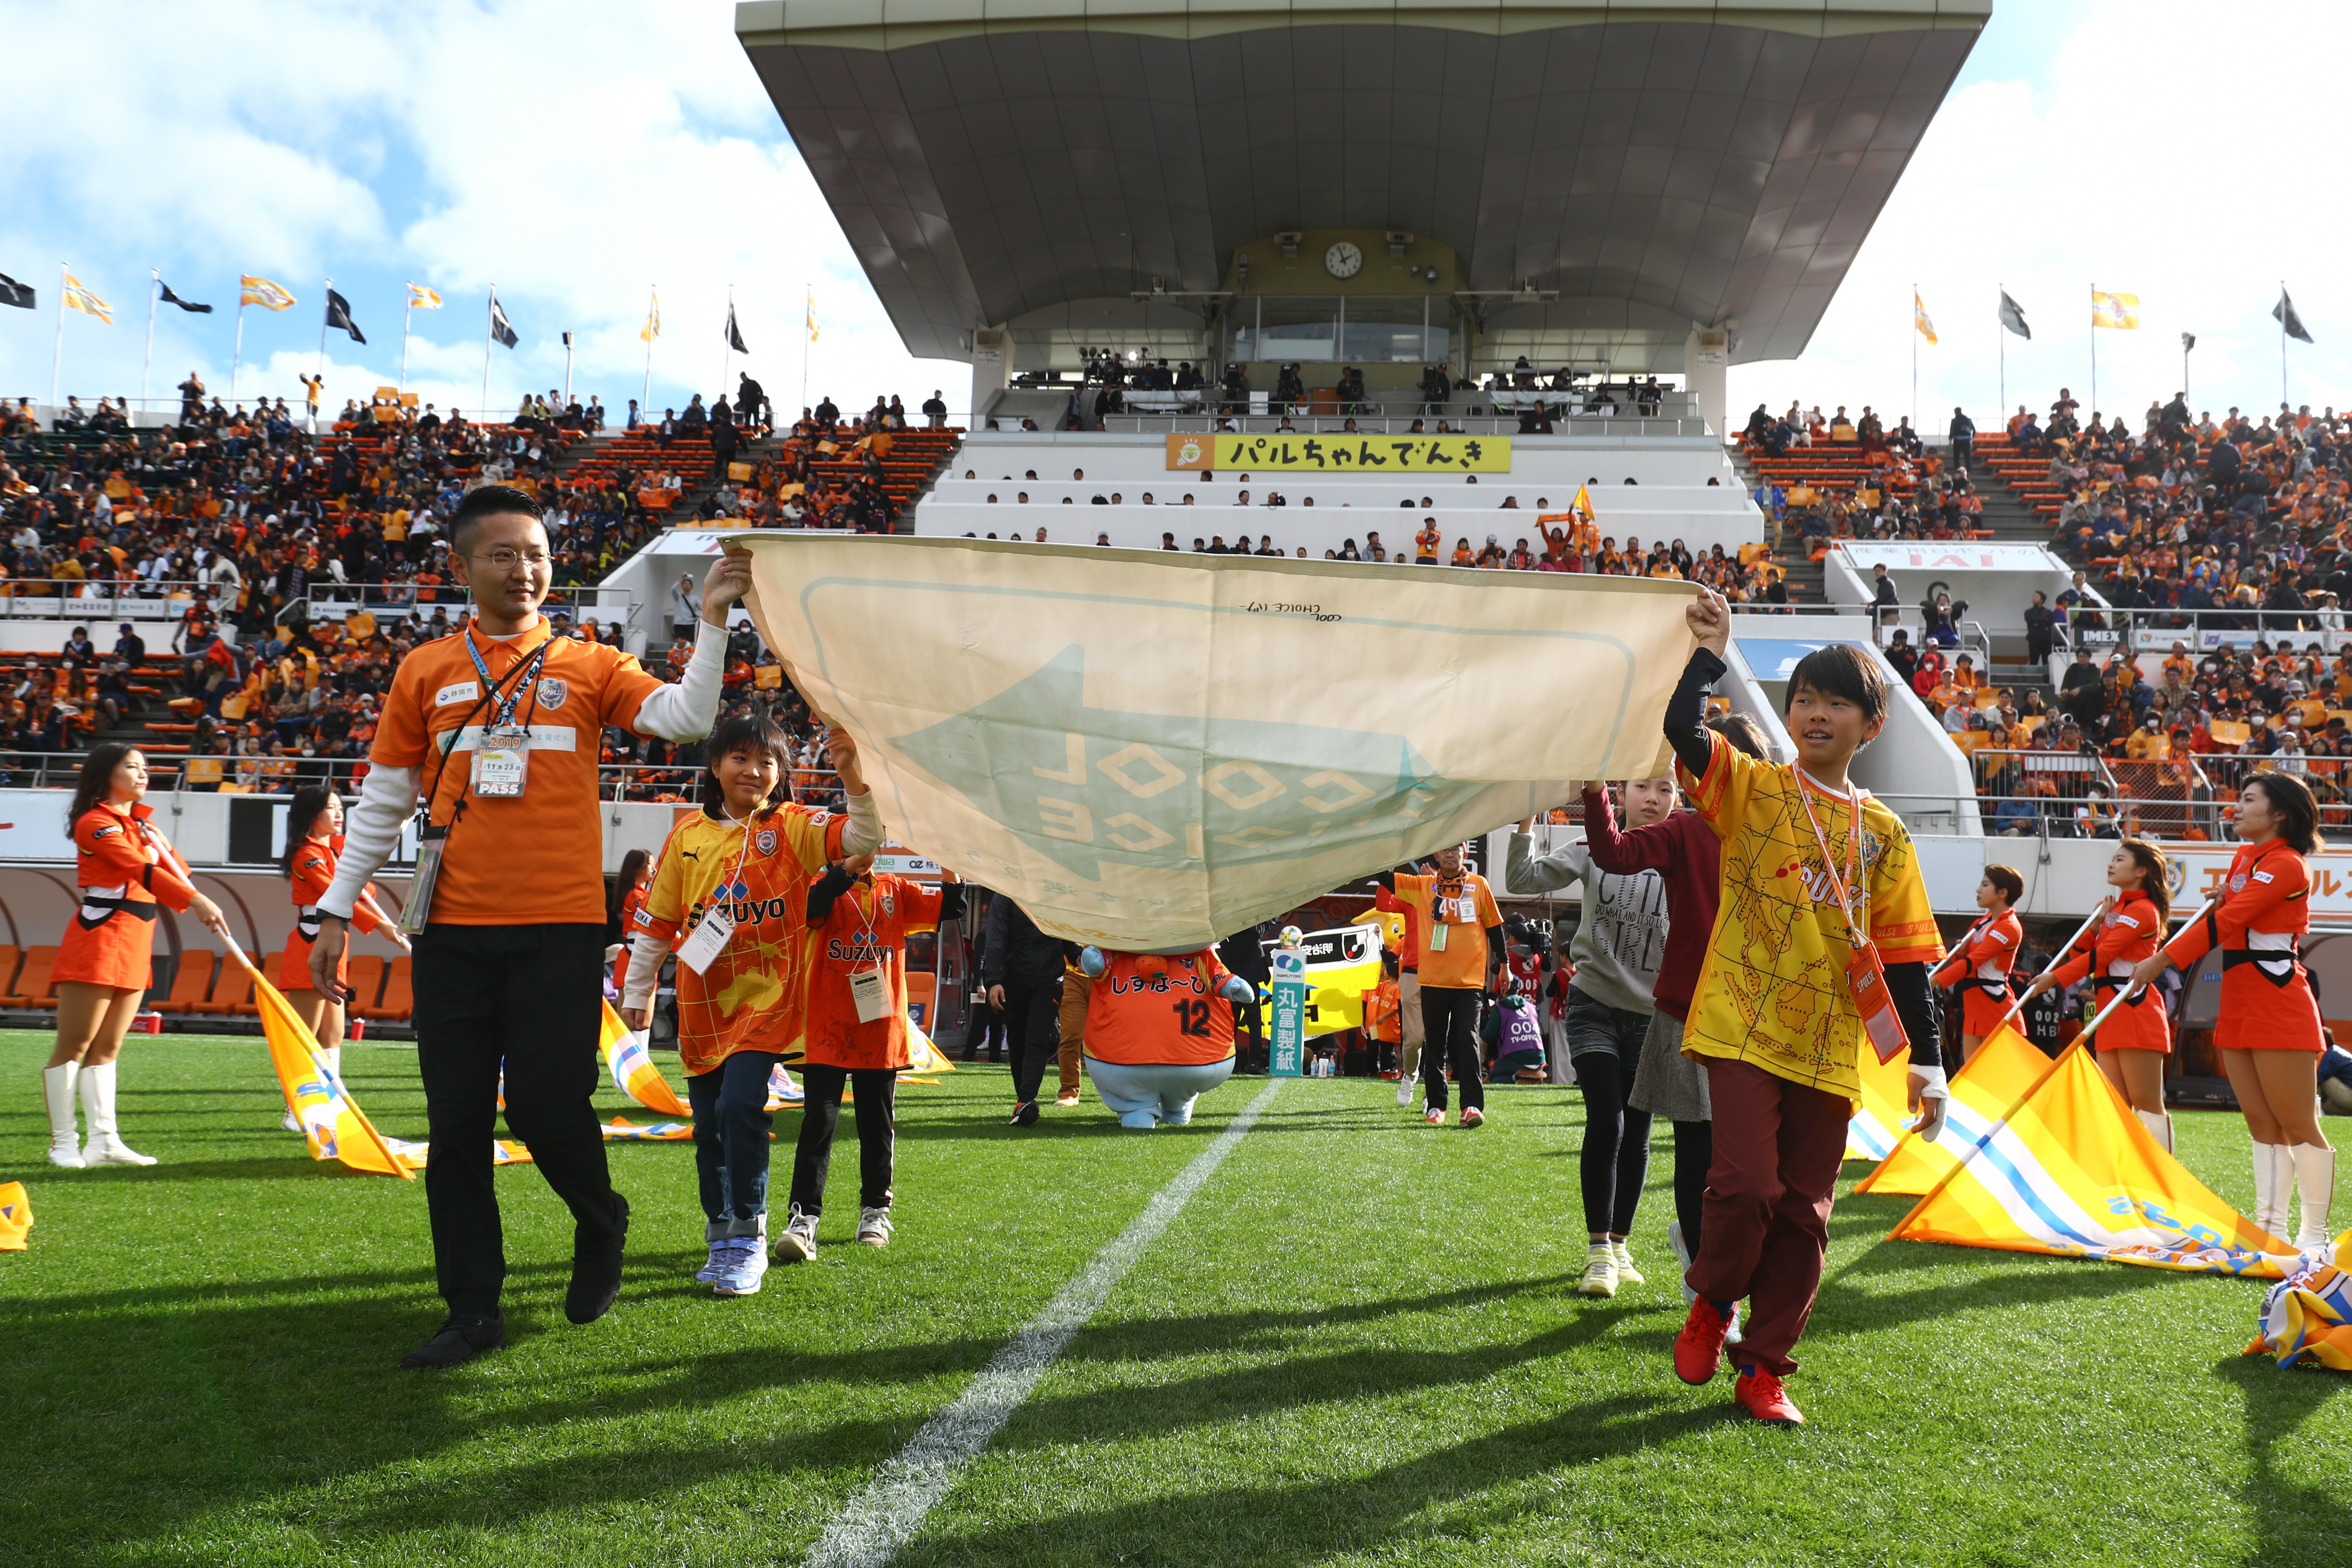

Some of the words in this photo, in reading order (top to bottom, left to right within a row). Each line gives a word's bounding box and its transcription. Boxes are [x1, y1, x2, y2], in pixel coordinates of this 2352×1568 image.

[1230, 438, 1482, 469] パルちゃんでんき
[1909, 554, 1994, 567] IAI
[1272, 603, 1320, 612] CHOICE
[1310, 613, 1341, 622] COOL
[2083, 630, 2119, 642] IMEX
[451, 688, 473, 697] 静岡市
[488, 737, 521, 749] 2019
[478, 784, 518, 794] PASS
[687, 897, 786, 930] Szuyo
[1596, 904, 1604, 915] DO
[1624, 911, 1636, 922] AND
[1637, 914, 1645, 925] IT
[1646, 915, 1654, 926] SO
[827, 938, 895, 965] Suzuyo
[1173, 998, 1210, 1038] 12
[2035, 1010, 2059, 1023] 002
[1276, 987, 1298, 1072] 丸富製紙
[2037, 1024, 2057, 1037] HB
[1764, 1039, 1780, 1049] JAVA
